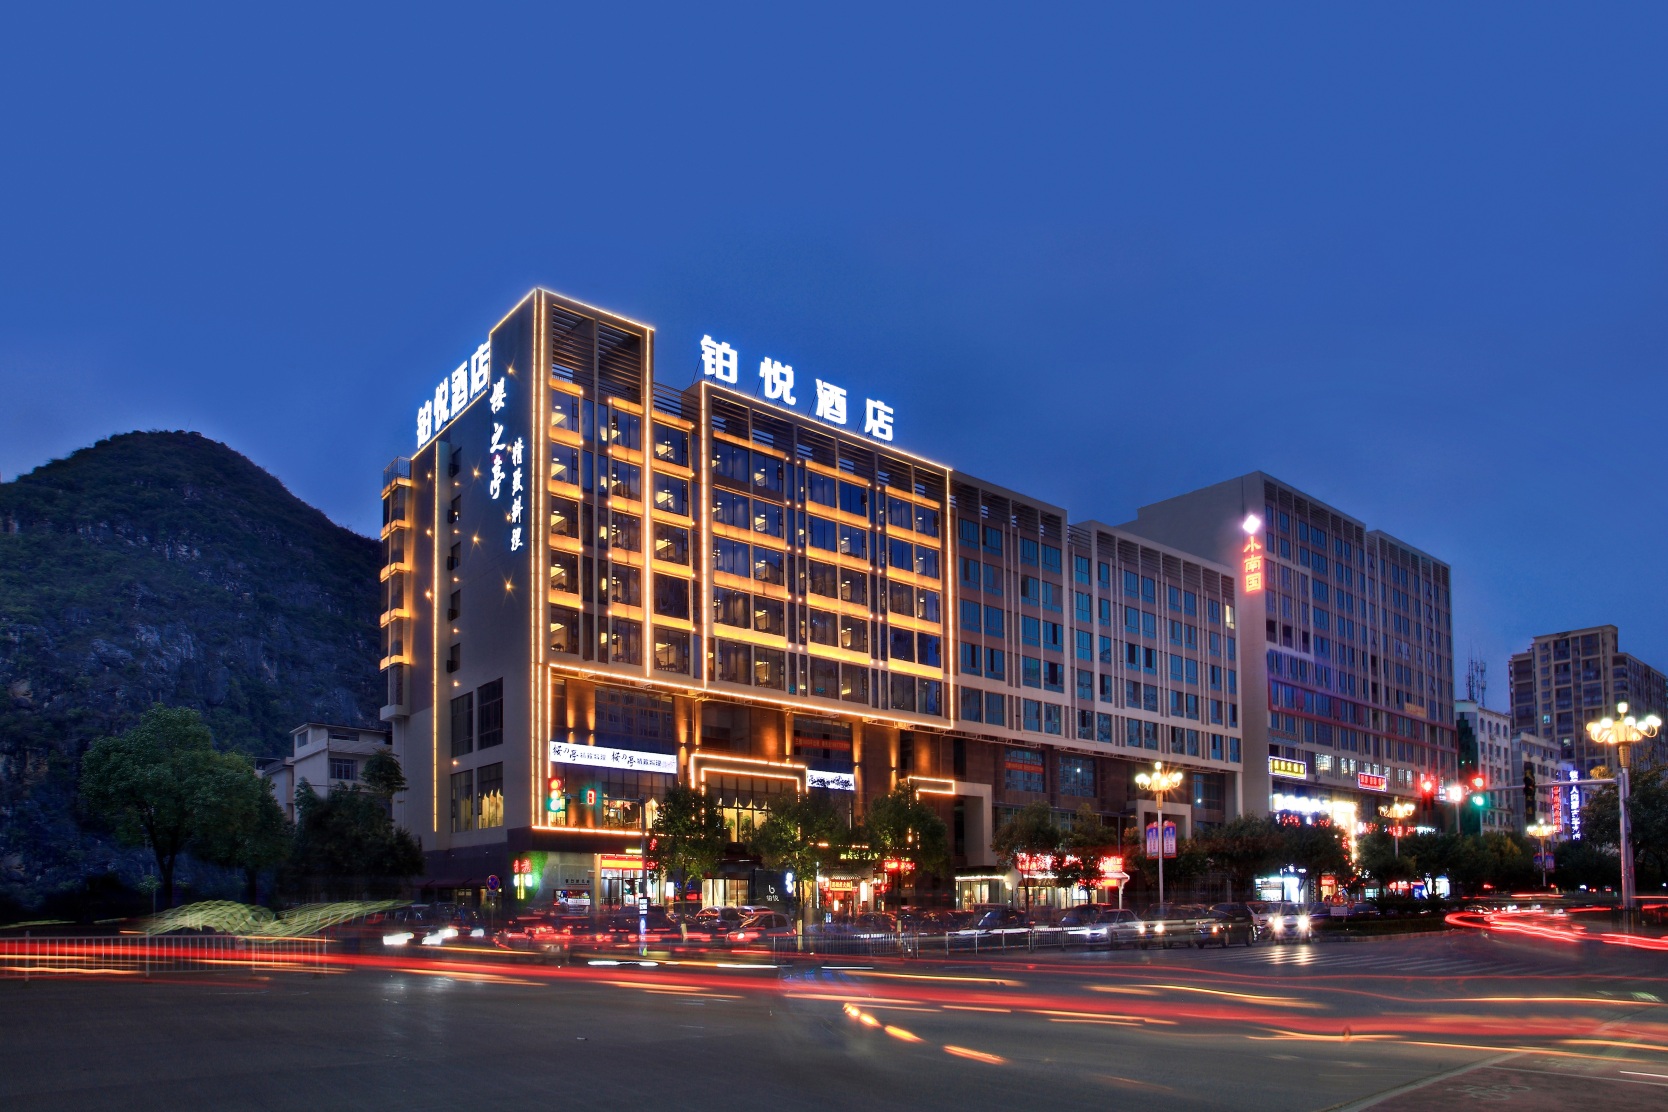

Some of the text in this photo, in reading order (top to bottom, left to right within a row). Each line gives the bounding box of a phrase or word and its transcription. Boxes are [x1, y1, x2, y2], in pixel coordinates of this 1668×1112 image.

[416, 341, 490, 449] 铂悦酒店
[701, 334, 894, 442] 铂悦酒店
